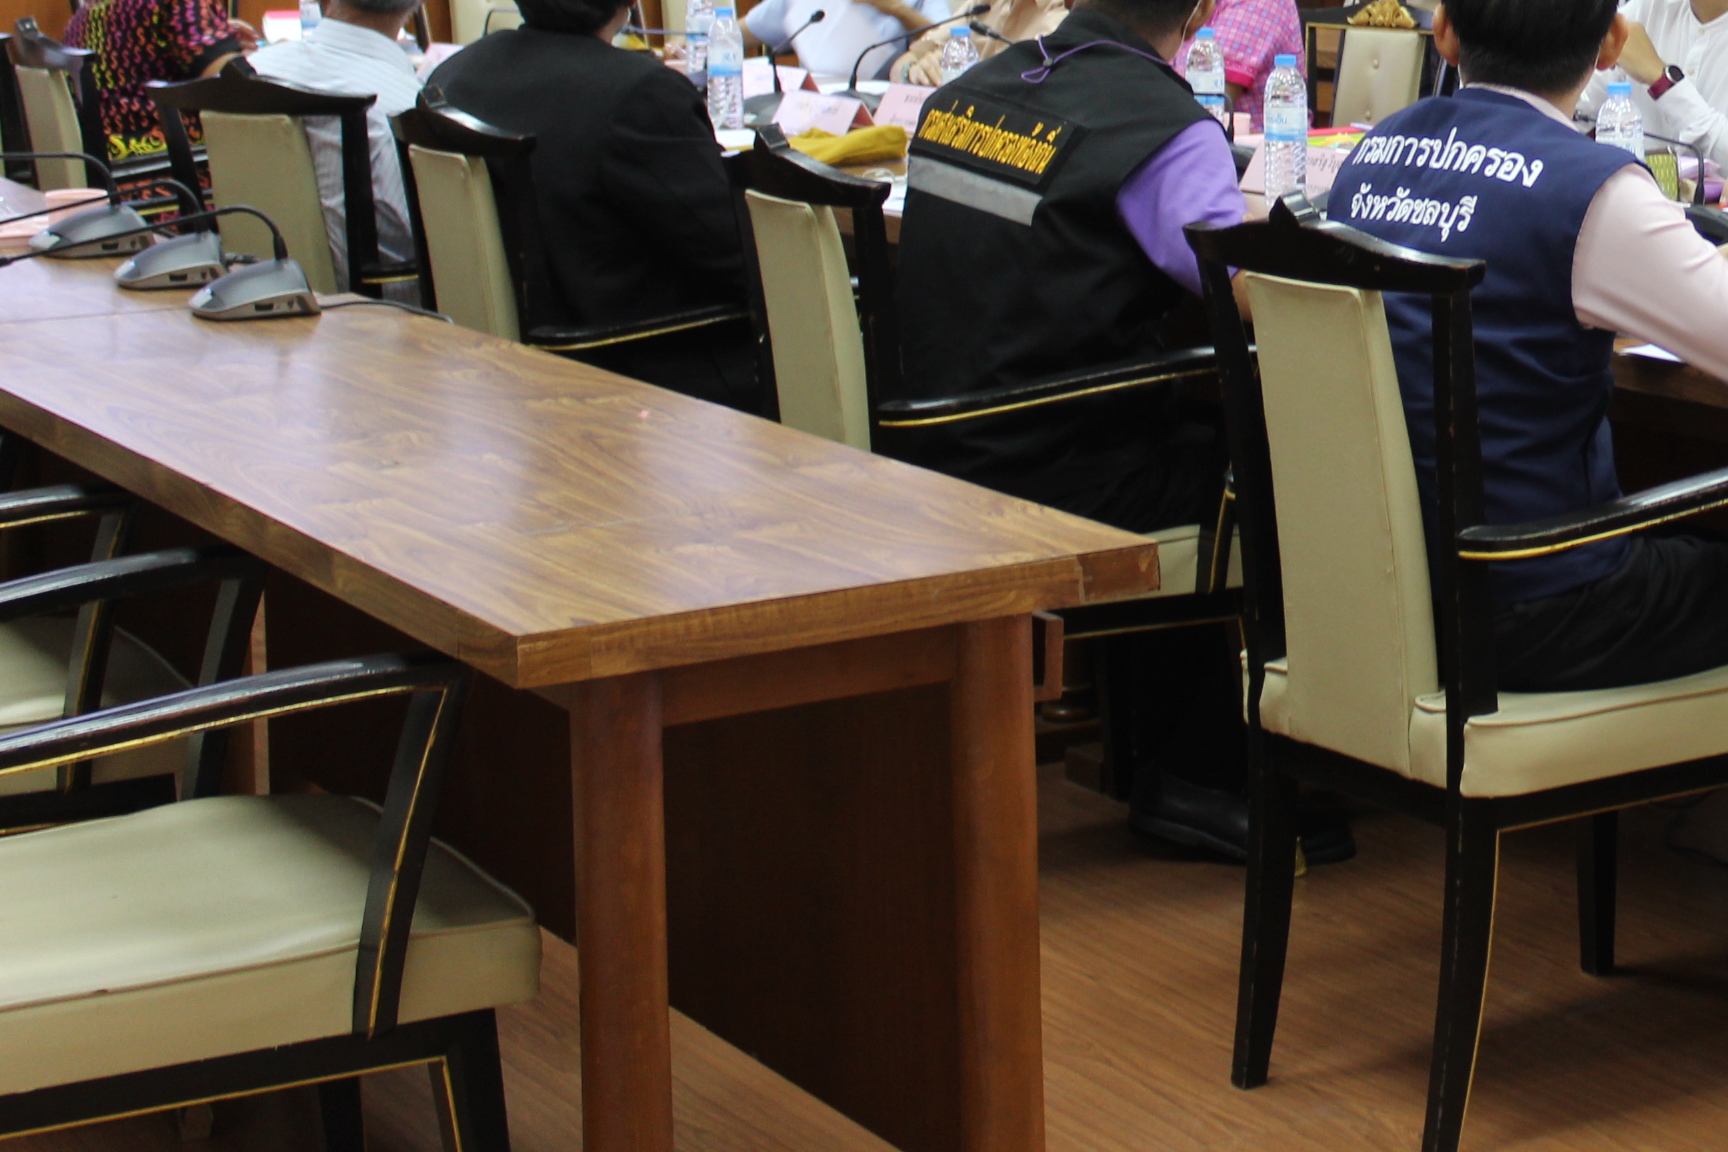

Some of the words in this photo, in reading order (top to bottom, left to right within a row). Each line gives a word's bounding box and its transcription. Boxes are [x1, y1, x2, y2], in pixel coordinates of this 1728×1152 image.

[1352, 127, 1543, 188] กรมการปกครอง
[1351, 183, 1477, 241] จังหวัดชลบุรี
